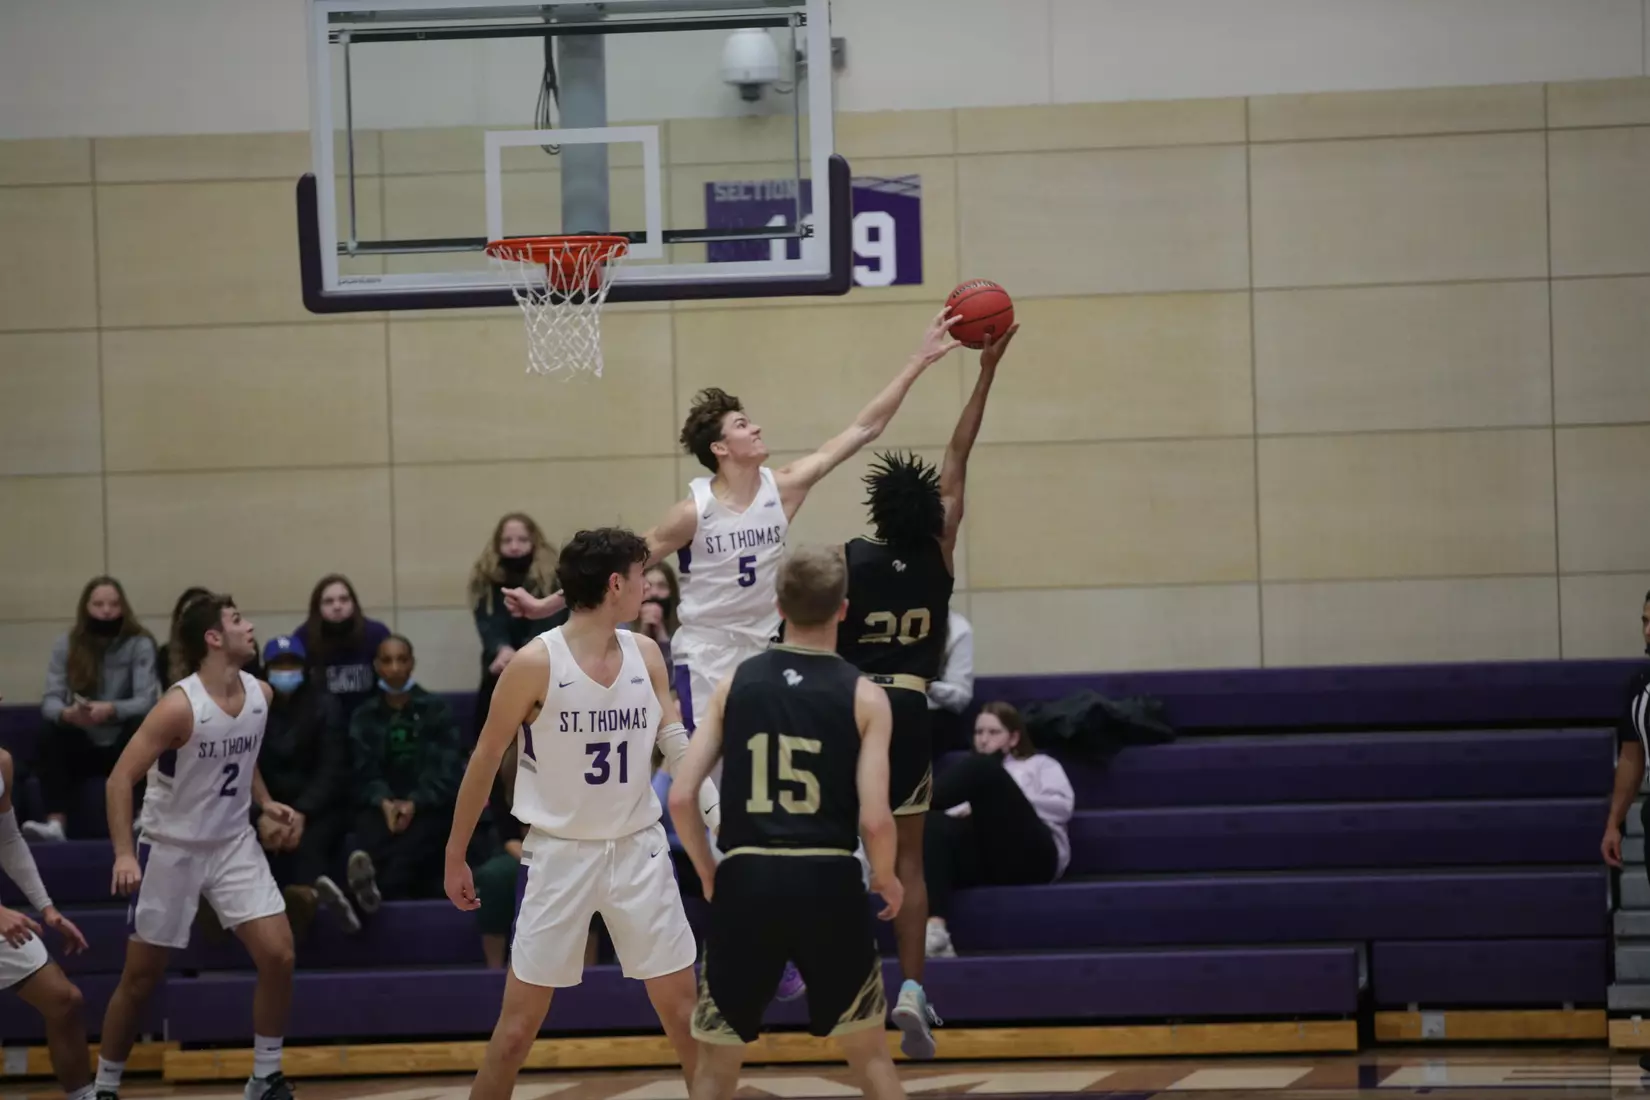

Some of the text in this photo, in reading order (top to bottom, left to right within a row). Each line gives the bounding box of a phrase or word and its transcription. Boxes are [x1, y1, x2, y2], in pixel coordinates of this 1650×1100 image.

[714, 180, 798, 202] SECTION
[706, 525, 781, 554] ST. THOMAS
[738, 555, 757, 588] 5
[858, 607, 931, 645] 20
[560, 707, 648, 733] ST. THOMAS
[198, 741, 218, 759] ST.
[584, 740, 628, 785] 31
[219, 763, 240, 797] 2
[746, 732, 822, 814] 15
